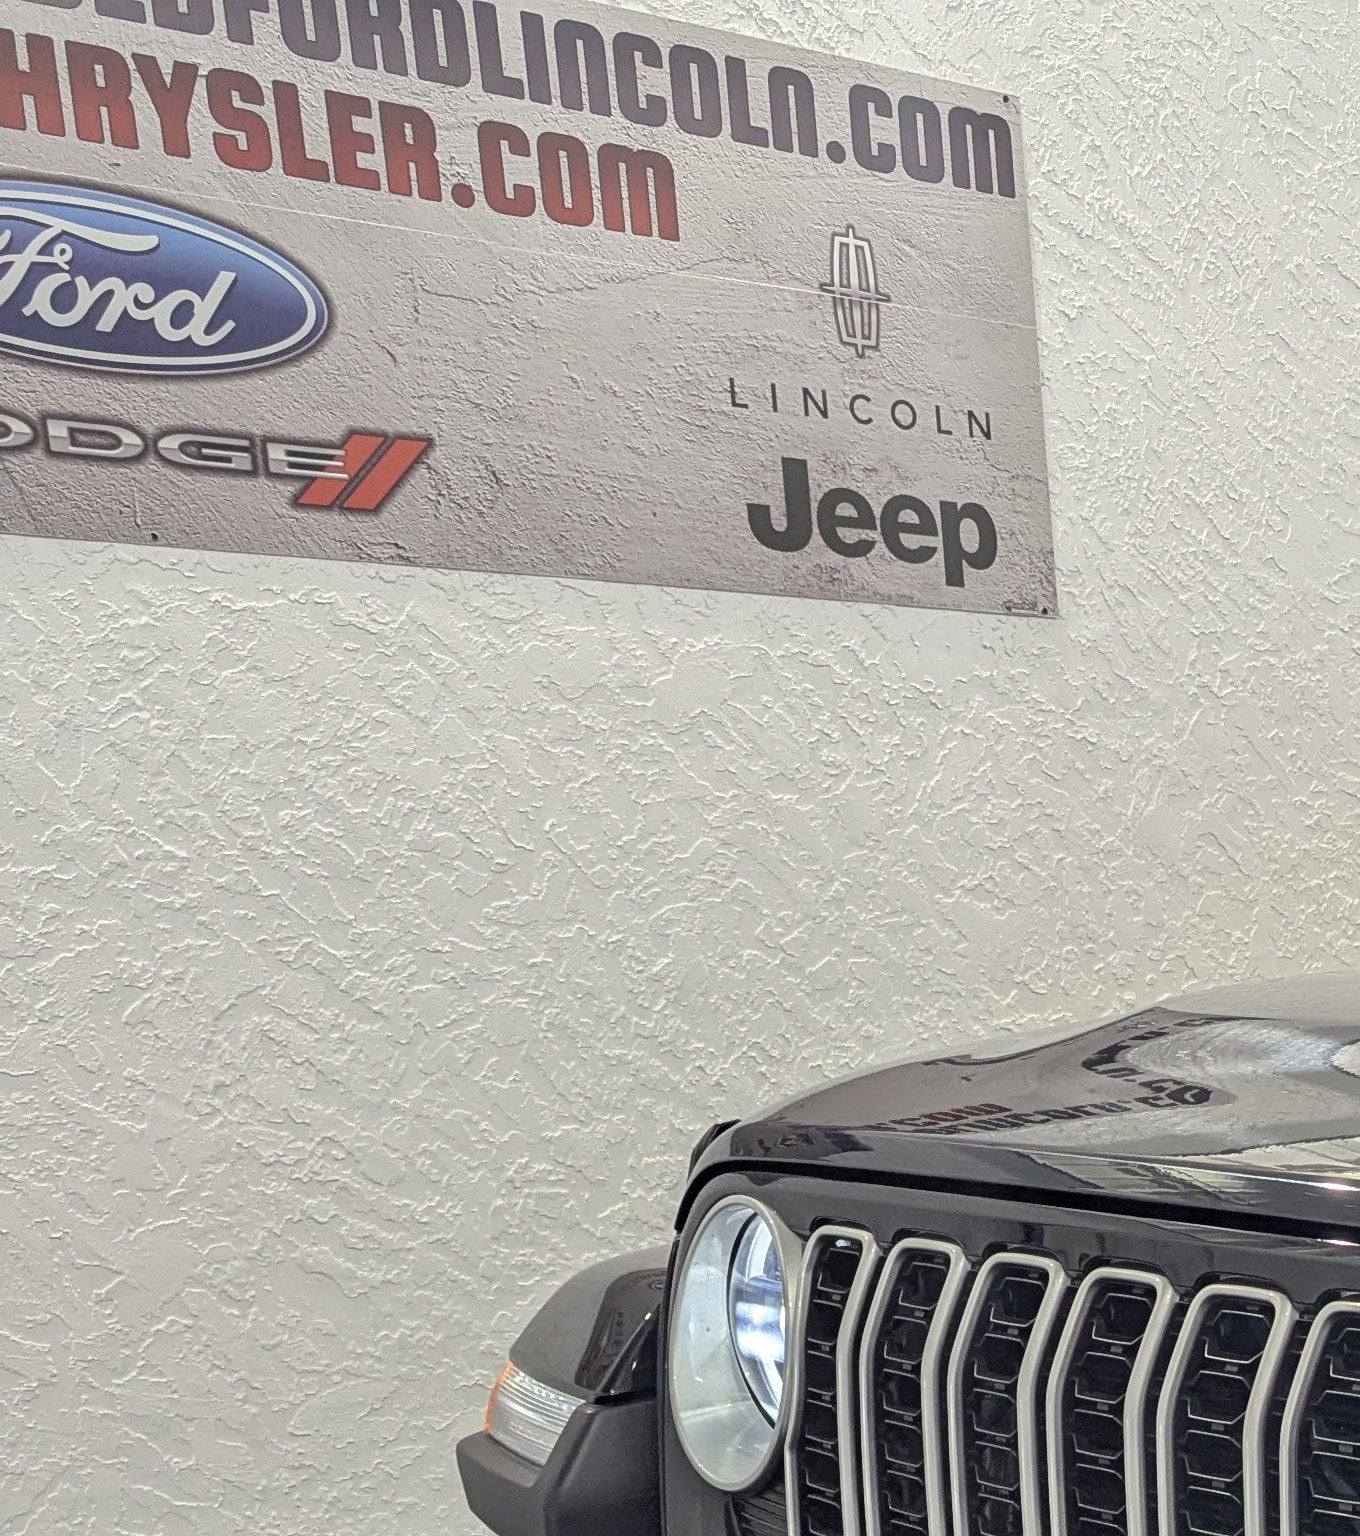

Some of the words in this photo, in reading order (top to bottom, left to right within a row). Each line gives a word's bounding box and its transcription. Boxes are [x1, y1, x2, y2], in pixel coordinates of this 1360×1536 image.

[0, 205, 236, 346] Ford
[729, 377, 992, 440] LINCOLN
[746, 456, 998, 587] Jeep
